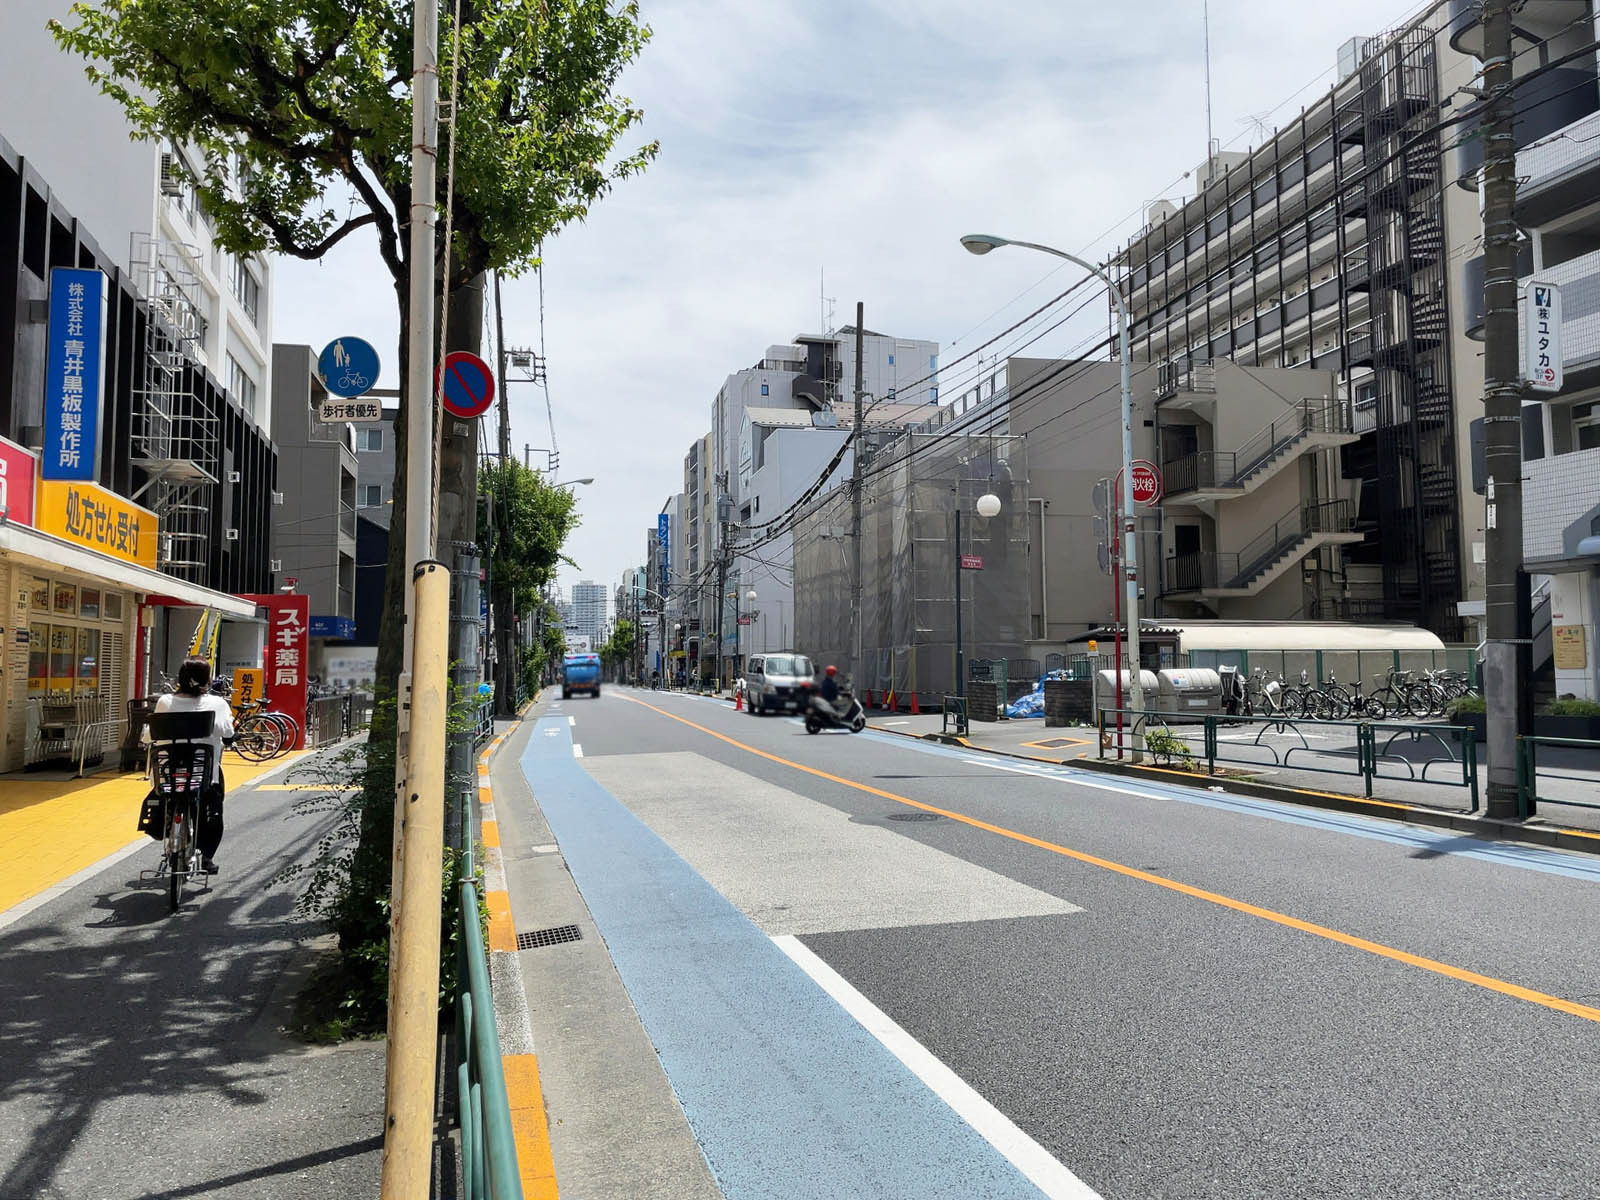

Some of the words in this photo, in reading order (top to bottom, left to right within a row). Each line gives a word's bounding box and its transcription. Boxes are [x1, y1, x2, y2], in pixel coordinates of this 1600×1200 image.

[58, 282, 85, 469] 株式会社青井黒板製作所
[323, 404, 378, 418] 歩行者優先
[65, 486, 140, 557] 処方せん受付
[274, 608, 306, 686] スギ薬局
[240, 673, 255, 710] 処方せ
